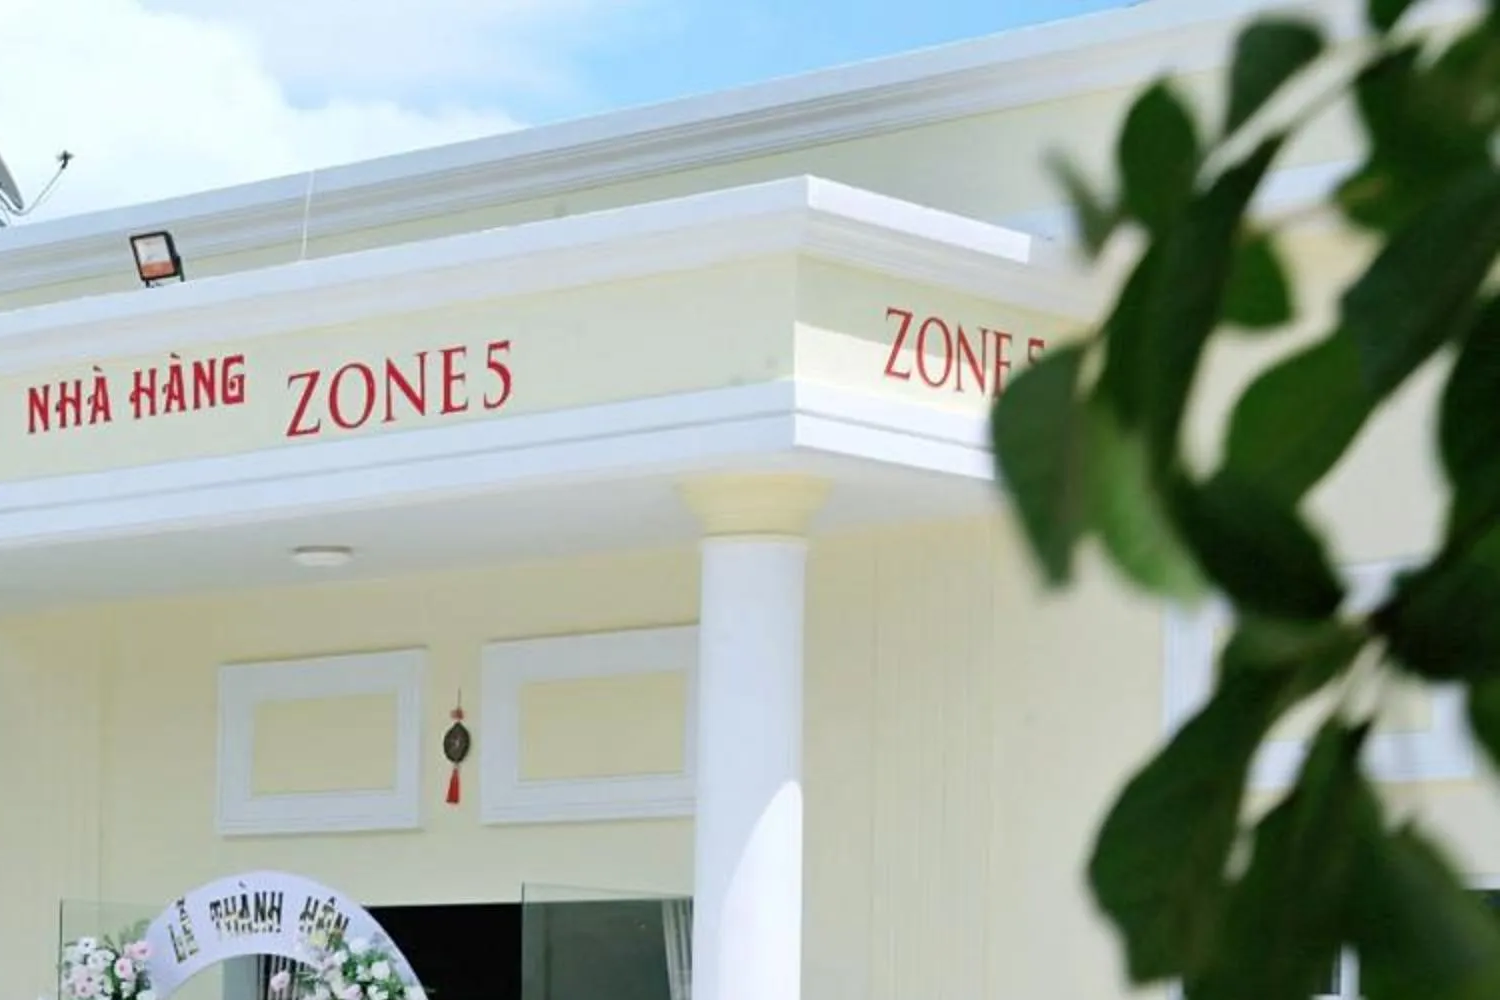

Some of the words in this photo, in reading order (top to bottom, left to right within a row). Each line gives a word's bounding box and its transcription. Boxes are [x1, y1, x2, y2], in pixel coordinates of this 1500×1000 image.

[27, 365, 113, 434] NHÀ
[129, 353, 246, 419] HÀNG
[209, 880, 284, 933] THÀNH
